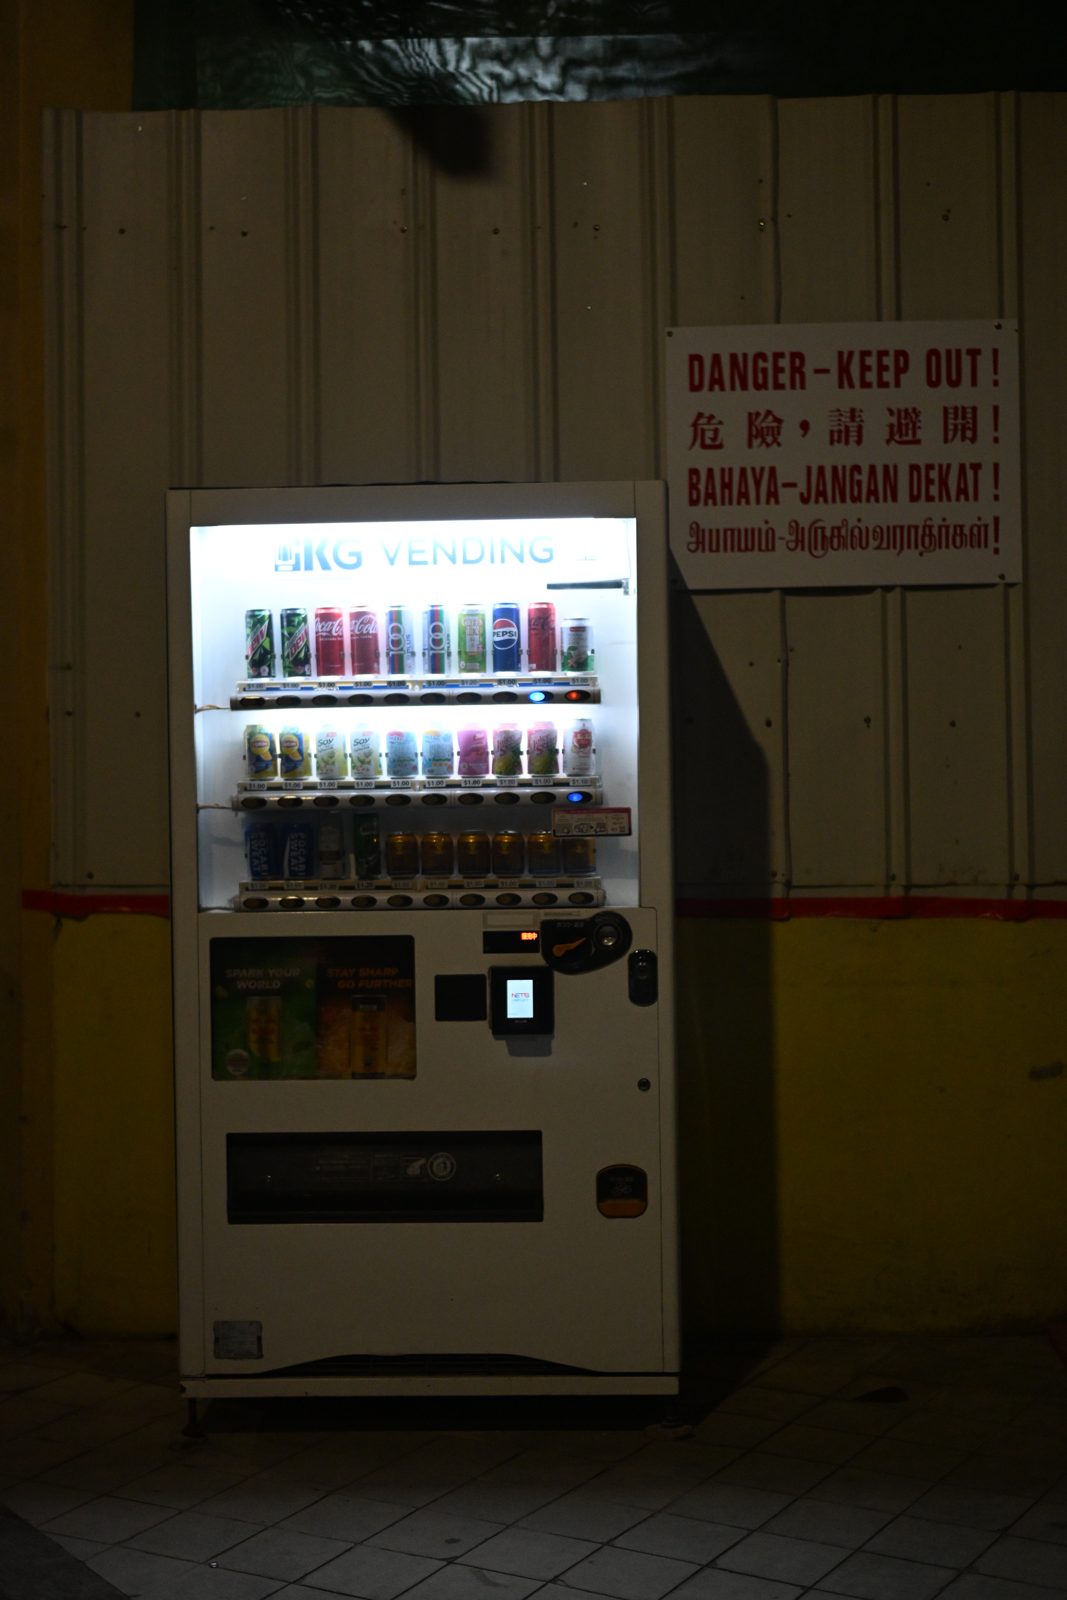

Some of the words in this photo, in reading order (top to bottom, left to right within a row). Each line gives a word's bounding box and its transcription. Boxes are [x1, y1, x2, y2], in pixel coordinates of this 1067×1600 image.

[382, 536, 555, 567] VENDING
[224, 968, 264, 978] SPARK
[269, 967, 300, 977] YOUR
[326, 968, 356, 977] STAY
[359, 966, 400, 977] SHARP
[236, 979, 281, 990] WORLD
[337, 979, 354, 989] GO
[358, 978, 413, 989] FURTHER
